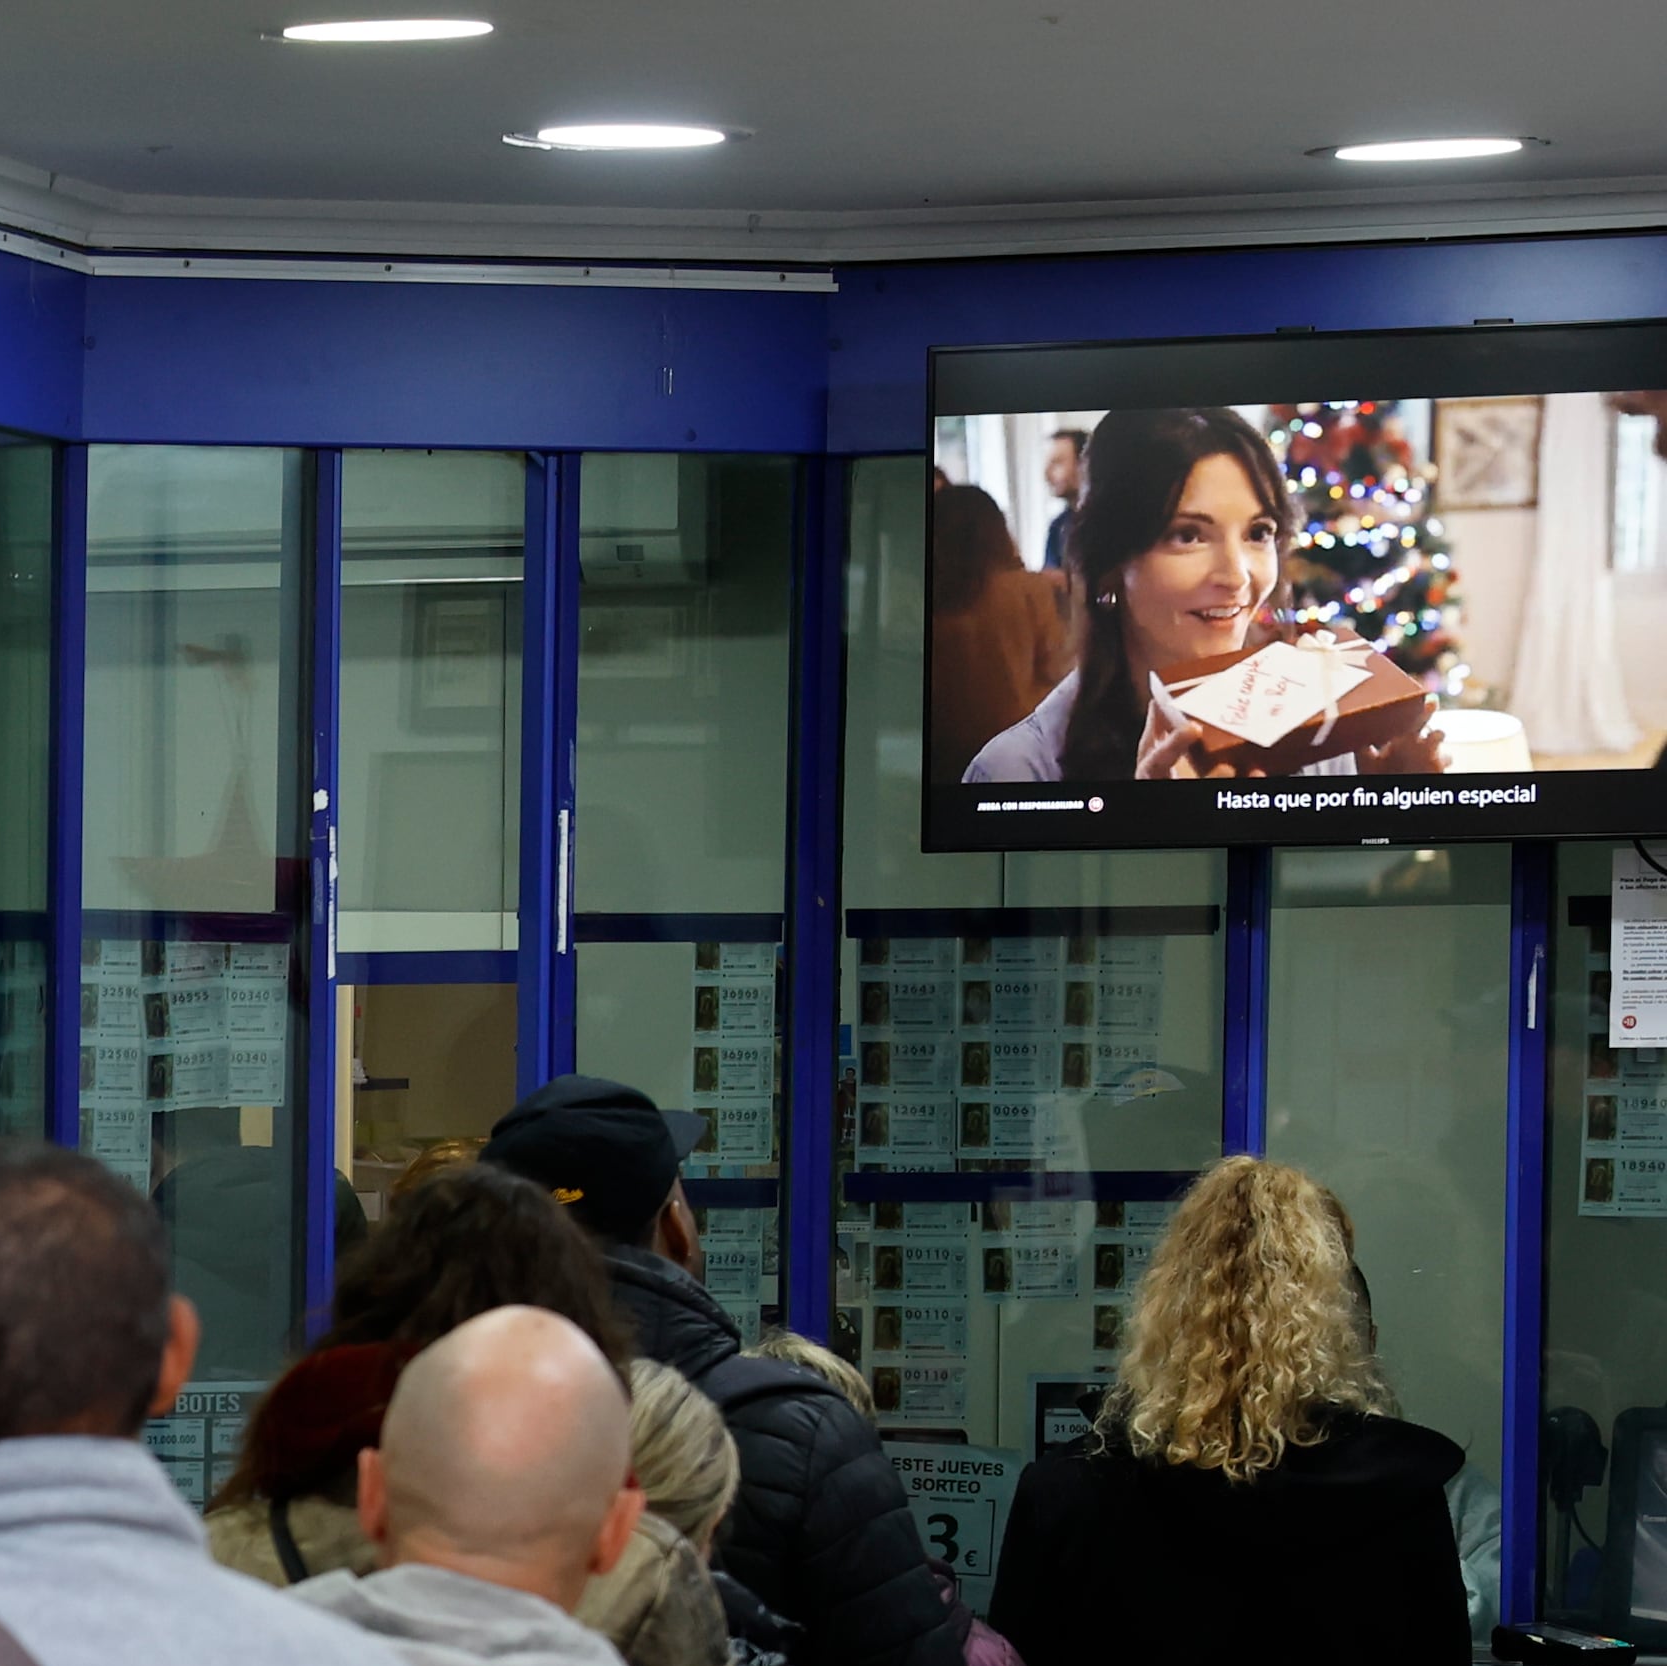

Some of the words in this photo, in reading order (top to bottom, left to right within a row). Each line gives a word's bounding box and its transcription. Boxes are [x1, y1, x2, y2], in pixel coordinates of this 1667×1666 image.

[1216, 790, 1270, 809] Hasta
[1274, 793, 1311, 811] que
[1316, 790, 1349, 811] por
[1352, 788, 1378, 807] fin
[1382, 787, 1454, 810] alguien
[1458, 784, 1536, 807] especial
[894, 983, 936, 995] 12643
[995, 983, 1038, 994] 00661
[231, 990, 270, 1001] 00340
[894, 1044, 936, 1055] 12643
[994, 1044, 1038, 1054] 00661
[98, 1049, 138, 1061] 32580
[97, 1110, 135, 1122] 32580
[893, 1105, 936, 1116] 12643
[1621, 1161, 1666, 1172] 18940
[906, 1248, 950, 1260] 00110
[905, 1309, 949, 1320] 00110
[904, 1370, 949, 1381] 00110
[175, 1393, 241, 1413] BOTES
[147, 1434, 196, 1445] 31.000.000
[892, 1457, 934, 1472] ESTE
[938, 1459, 1004, 1477] JUEVES
[912, 1477, 981, 1494] SORTEO
